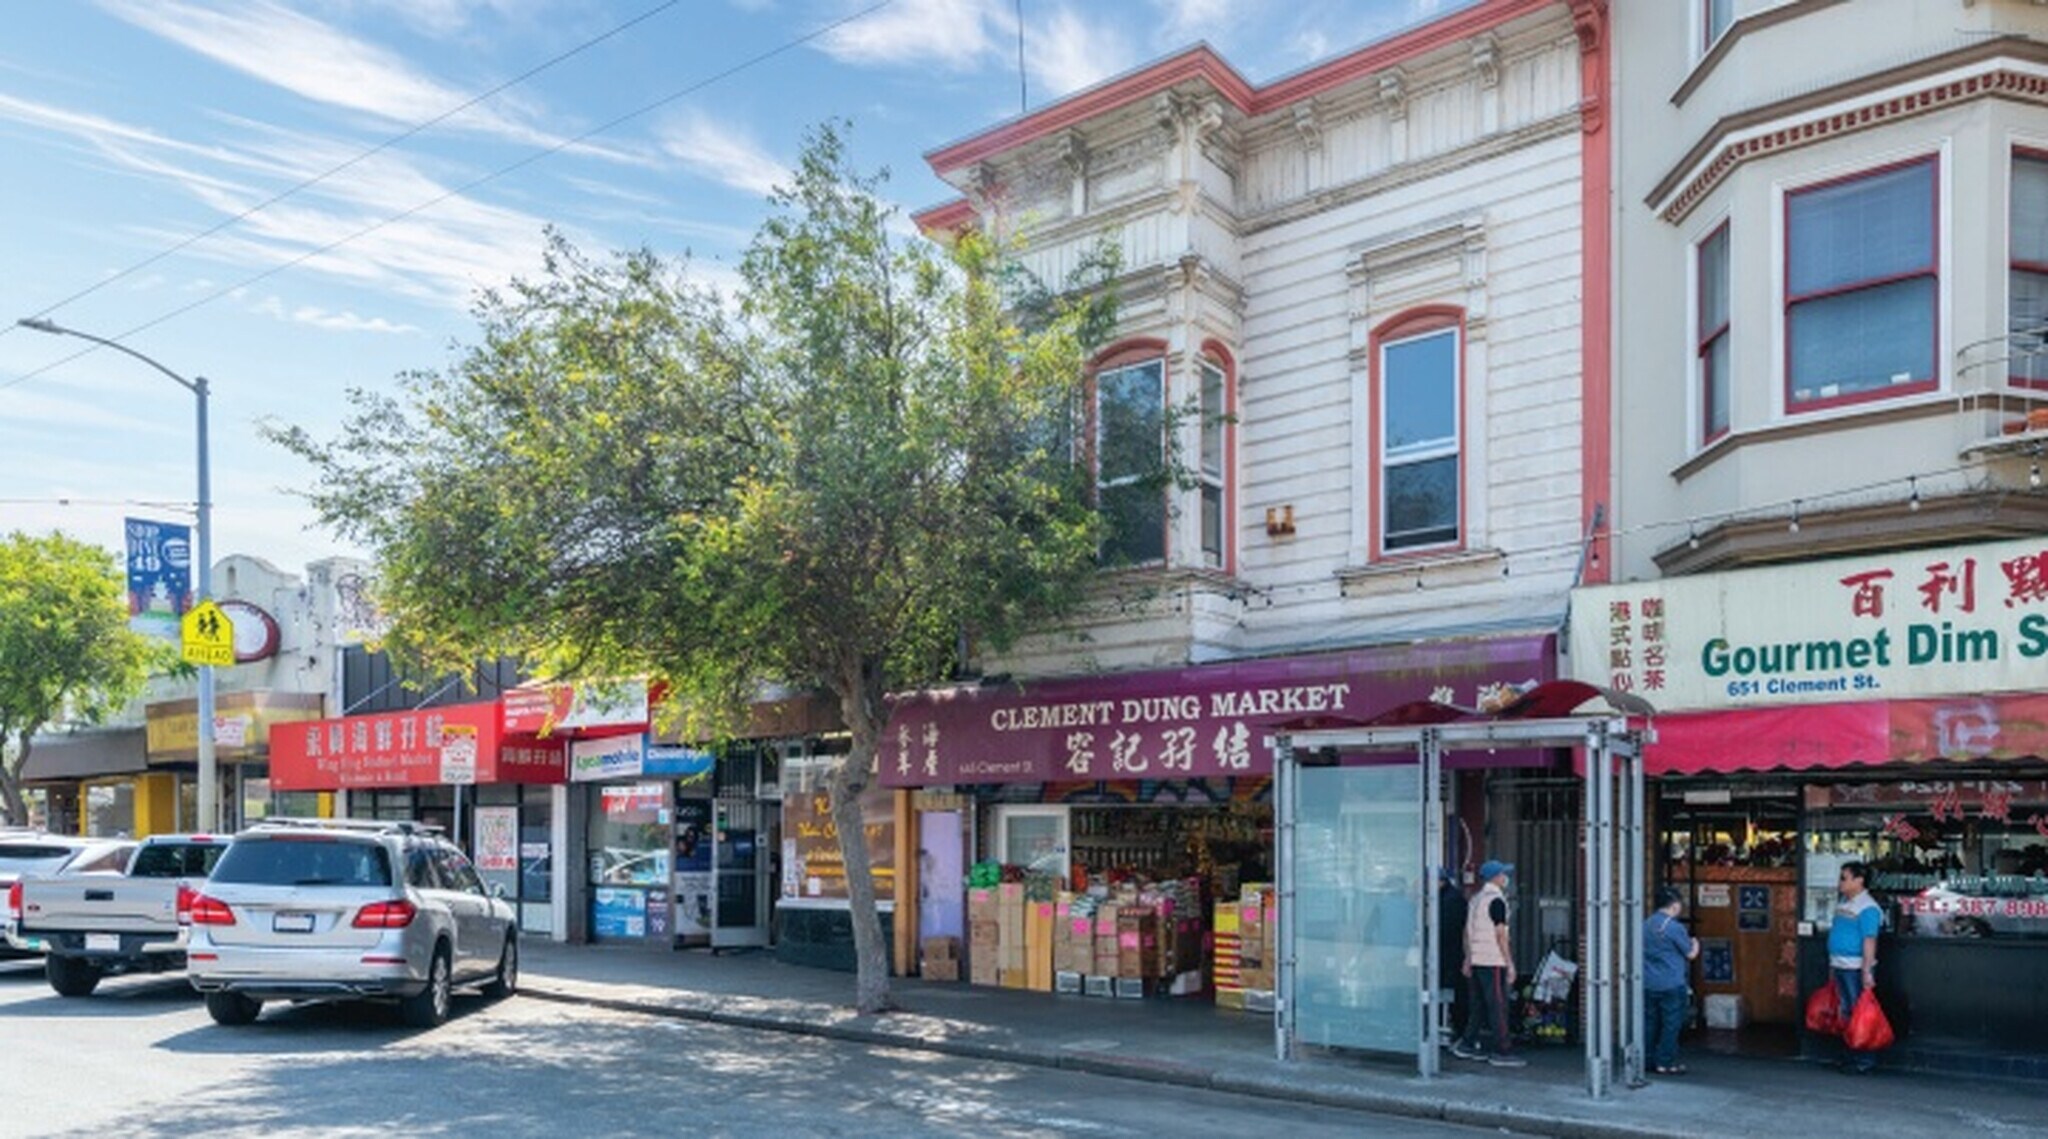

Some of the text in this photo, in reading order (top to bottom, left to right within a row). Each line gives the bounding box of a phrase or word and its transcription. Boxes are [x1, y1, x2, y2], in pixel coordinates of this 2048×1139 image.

[187, 647, 231, 661] AHEAD
[1609, 601, 1632, 693] 港式點心
[1642, 598, 1664, 691] 咖啡名茶
[1702, 628, 1891, 677] Gourmet
[1908, 624, 1998, 667] Dim
[1727, 672, 1881, 697] 651 Clement St.
[990, 683, 1350, 731] CLEMENT DUNG MARKET
[977, 760, 1020, 774] Clement
[1900, 896, 1949, 915] TEL:
